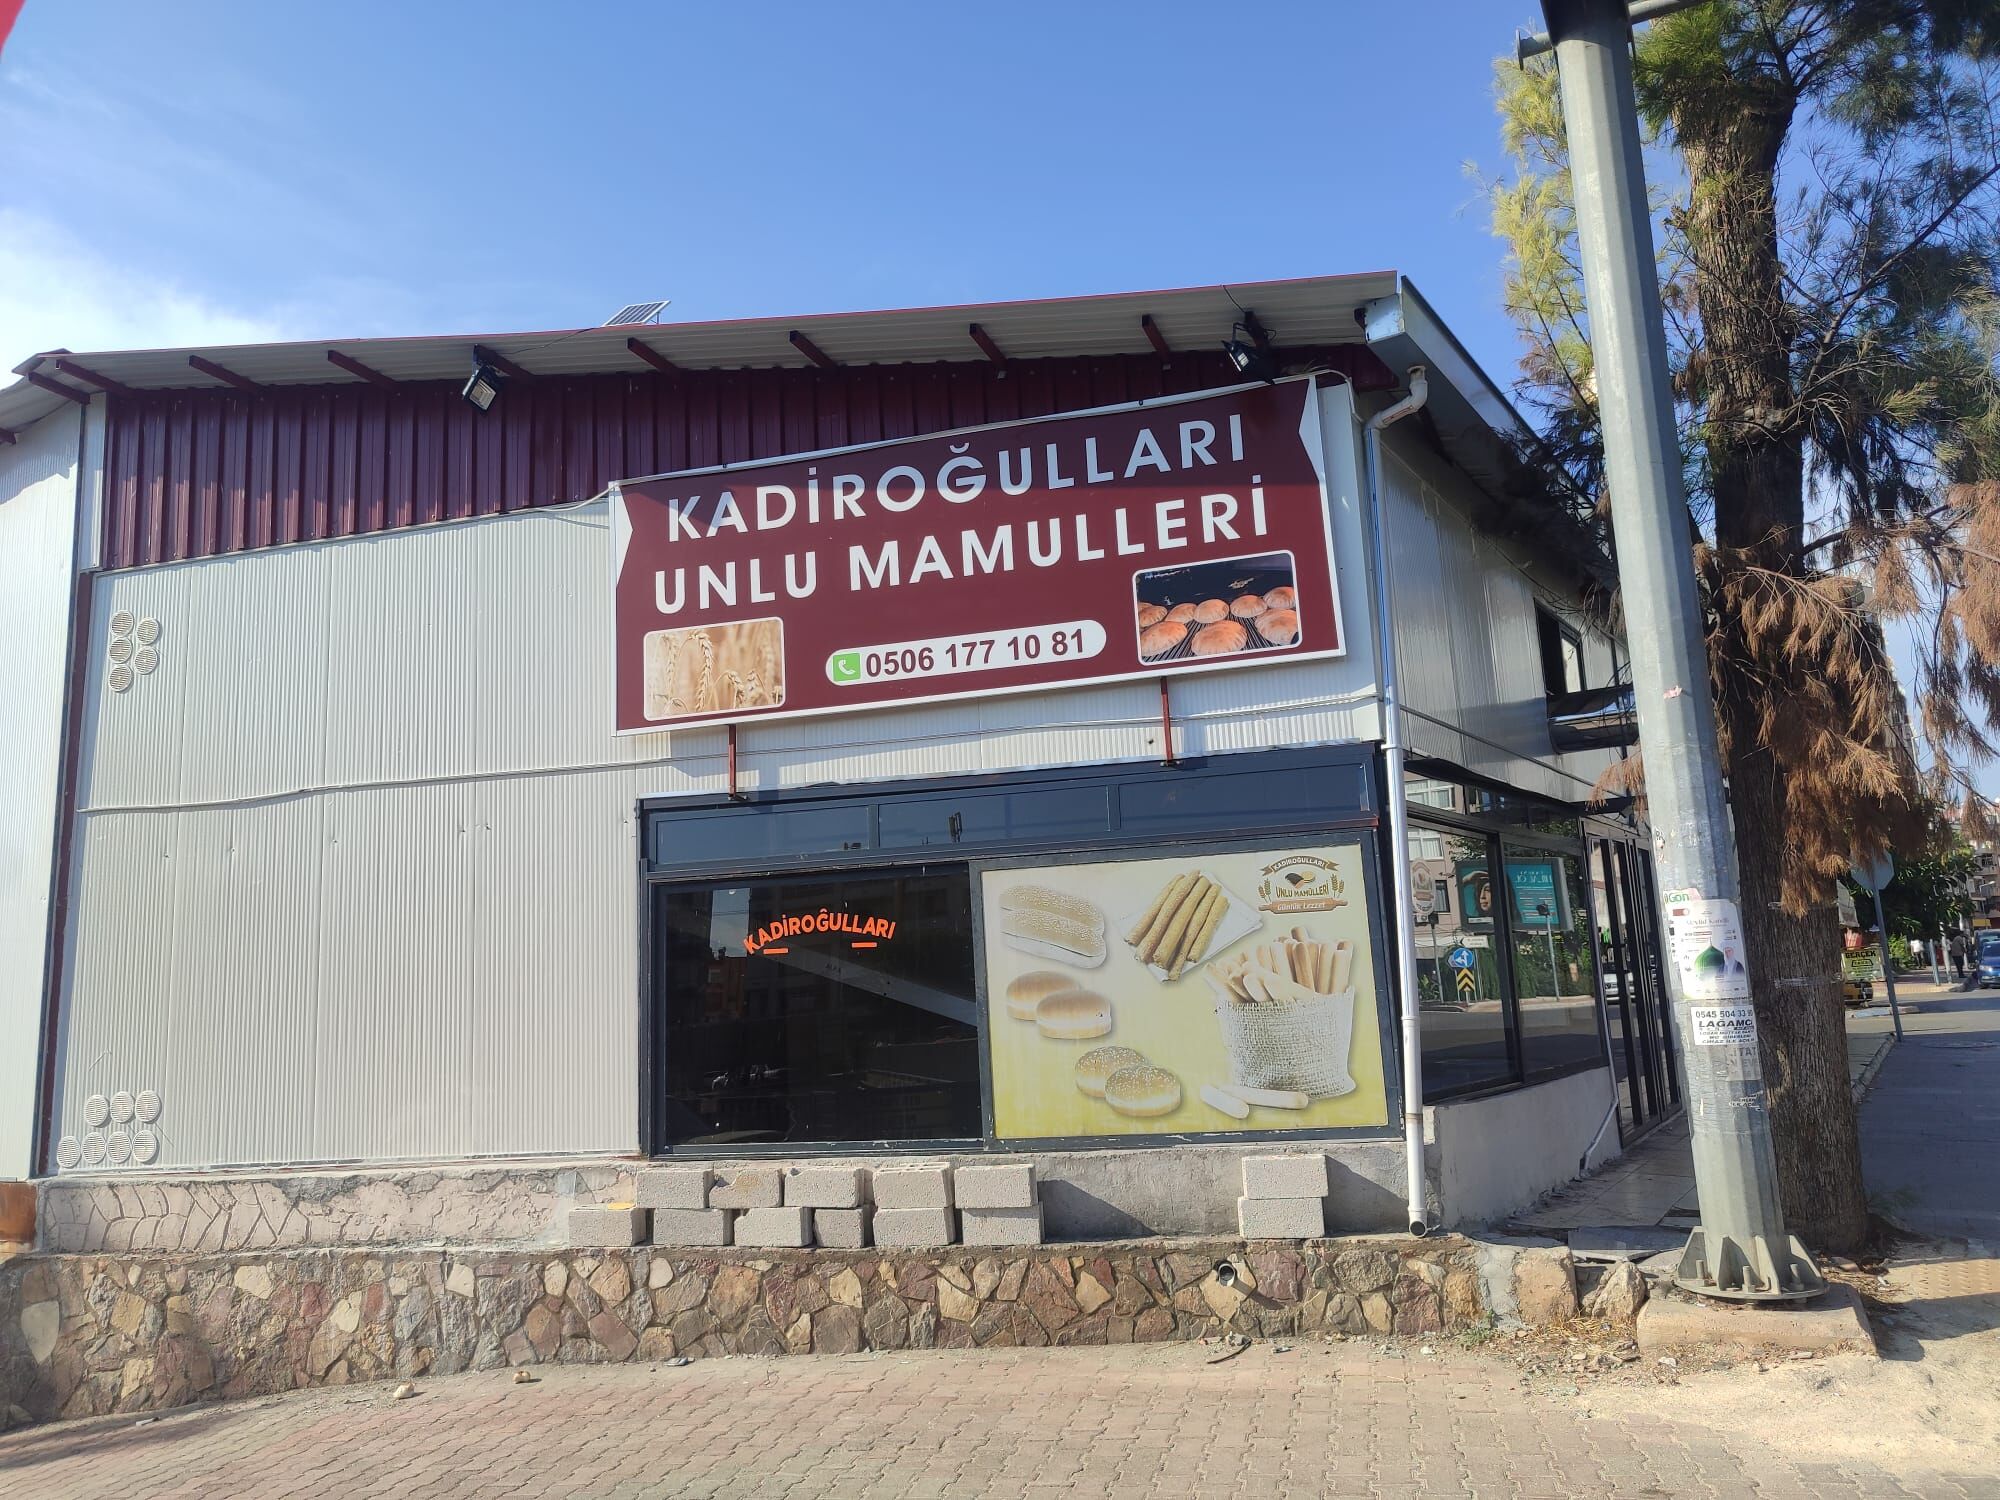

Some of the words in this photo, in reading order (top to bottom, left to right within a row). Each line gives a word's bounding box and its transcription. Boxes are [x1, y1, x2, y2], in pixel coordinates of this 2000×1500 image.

[669, 414, 1244, 542] KADİROĞULLARI
[655, 551, 817, 614] UNLU
[849, 474, 1267, 592] MAMULLERİ
[866, 647, 935, 678] 0506
[945, 639, 996, 668] 177
[1007, 634, 1041, 661] 10
[1051, 628, 1084, 656] 81
[743, 907, 897, 955] KADİROĞULLARI
[1695, 1010, 1717, 1019] 0545
[1719, 1010, 1736, 1018] 504
